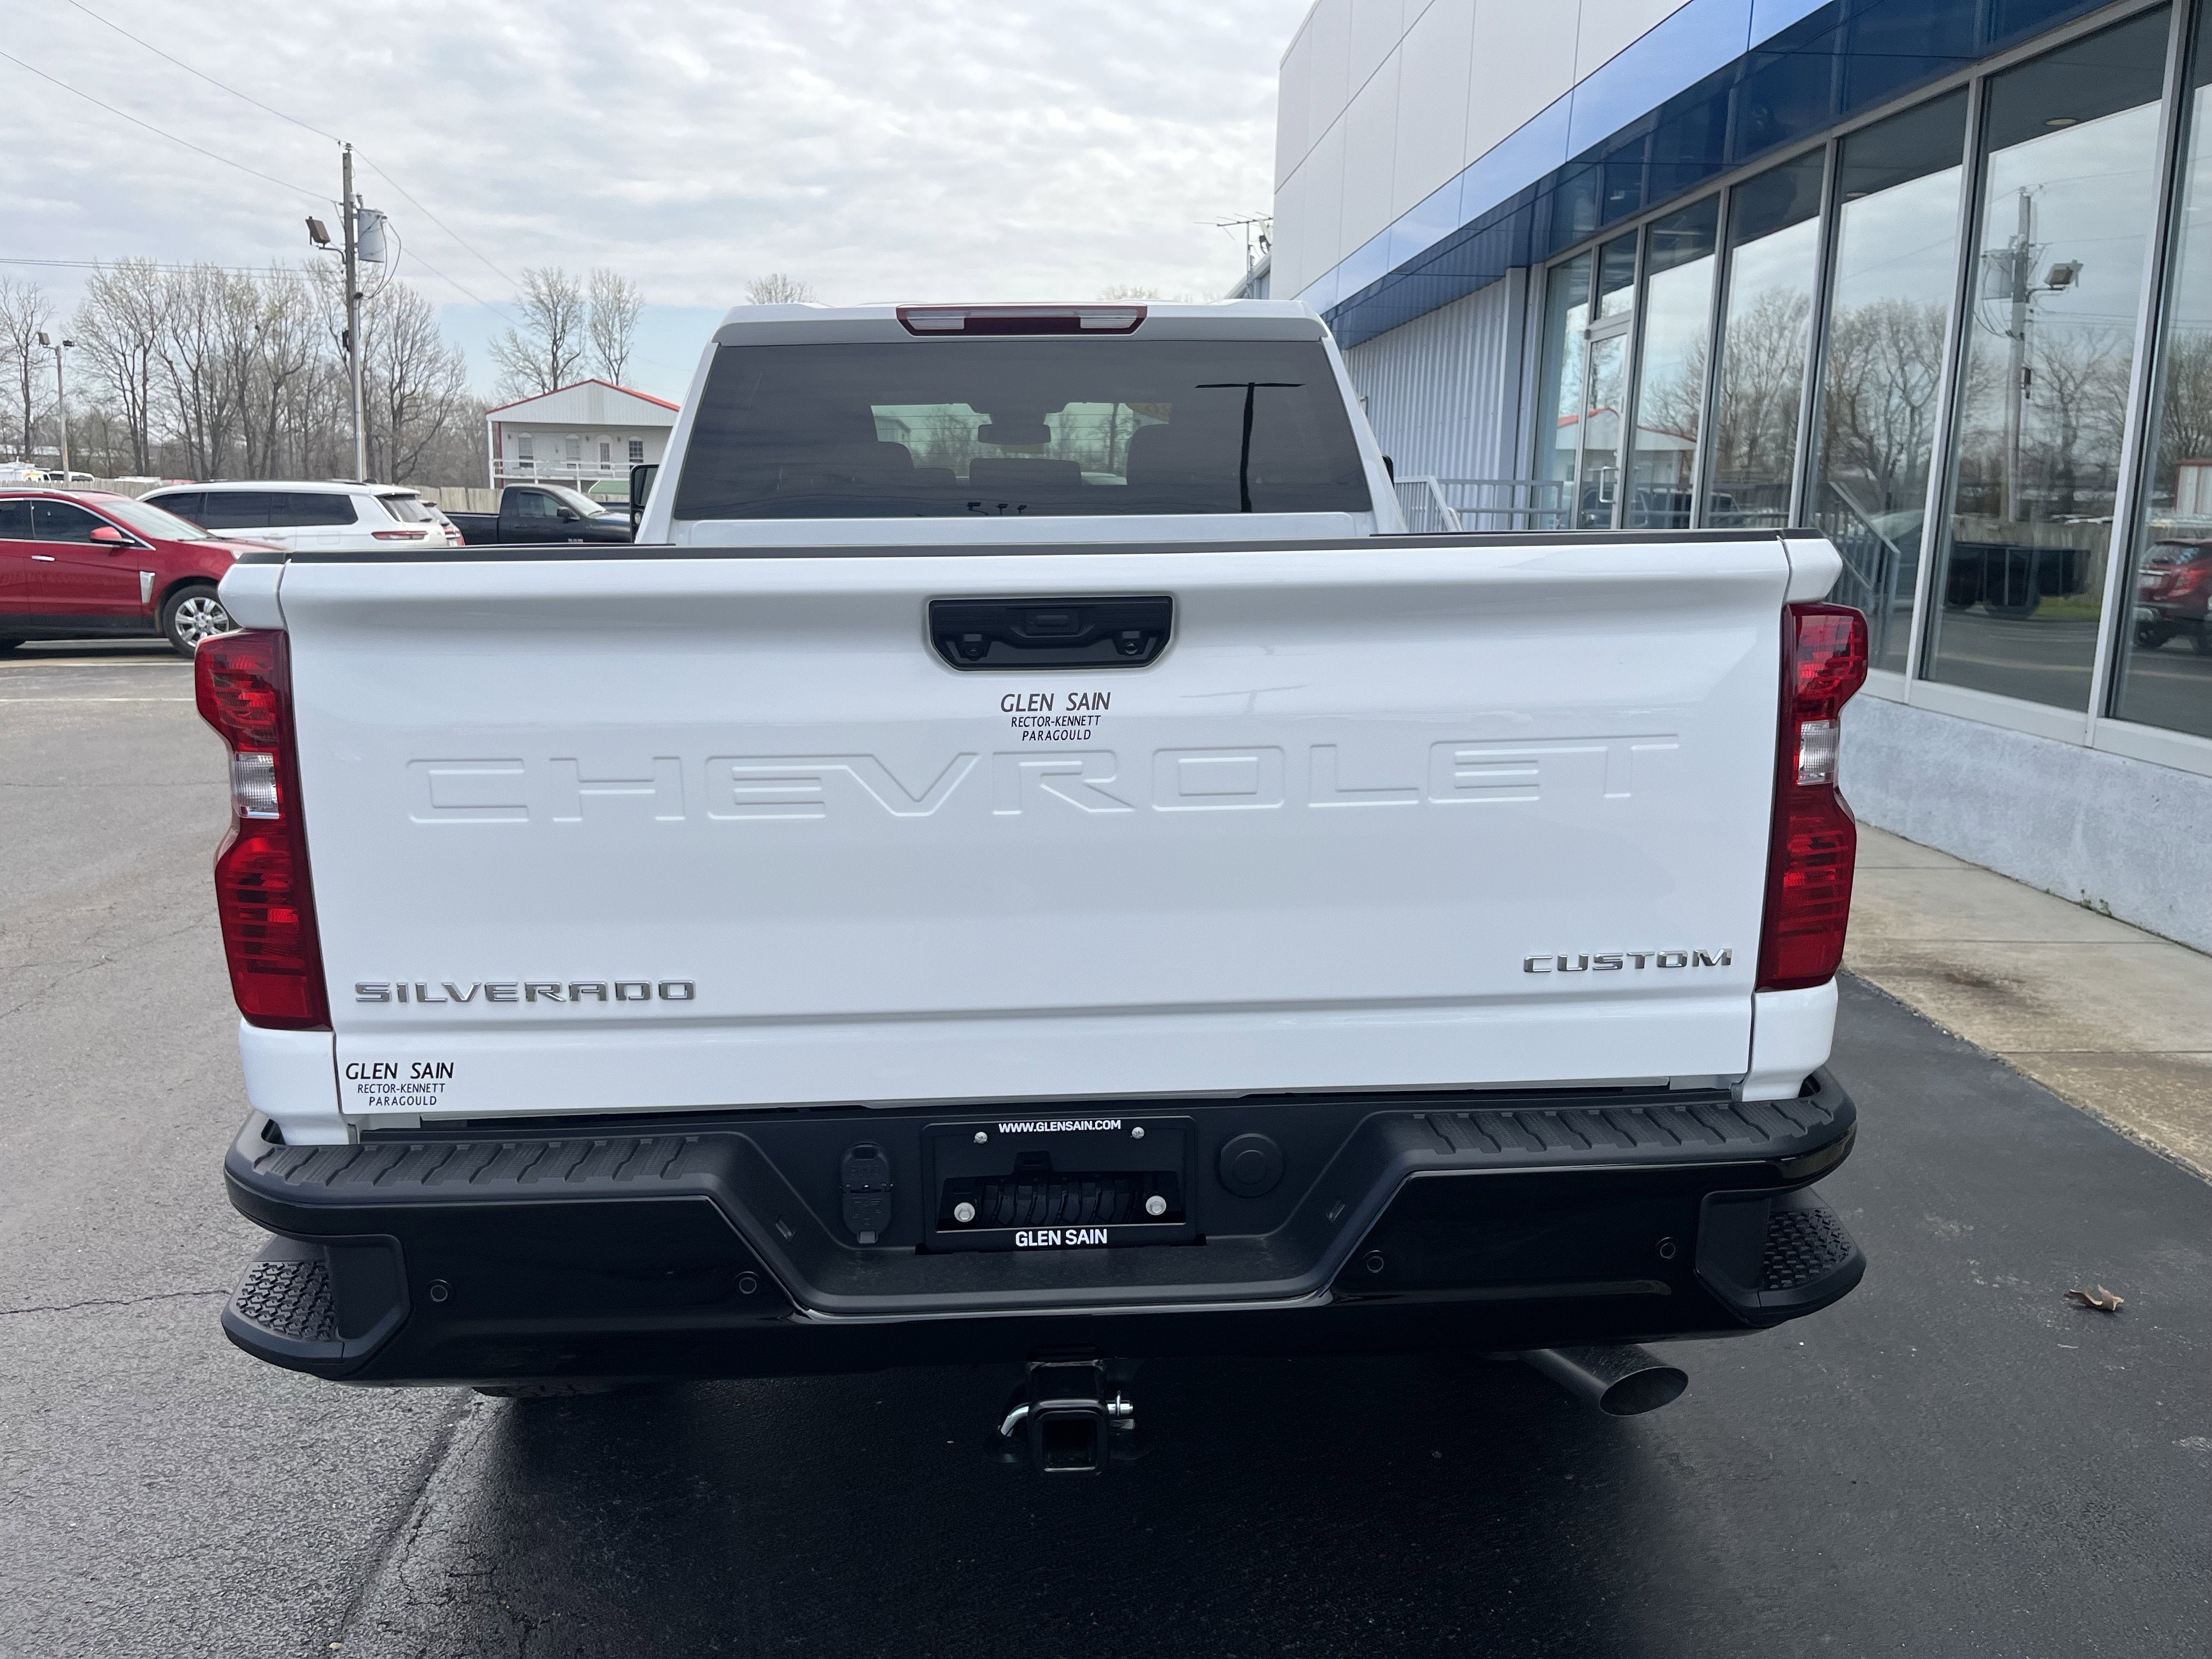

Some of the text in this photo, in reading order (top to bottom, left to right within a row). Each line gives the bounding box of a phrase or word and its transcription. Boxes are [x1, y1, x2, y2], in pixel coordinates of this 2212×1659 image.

[1001, 692, 1111, 713] GLEN SAIN
[1011, 715, 1102, 727] RECTOR-KENNETT
[1022, 729, 1091, 741] PARAGOULD
[405, 734, 1681, 824] CHEVROLET
[1523, 948, 1733, 974] CUSTOM
[354, 980, 695, 1003] SILVERADO
[346, 1062, 455, 1080] GLEN SAIN
[357, 1083, 446, 1094] RECTOR-KENNETT
[369, 1096, 437, 1107] PARAGOULD
[998, 1120, 1122, 1133] WWW.GLENSAIN.COM
[1014, 1228, 1108, 1248] GLEN SAIN
